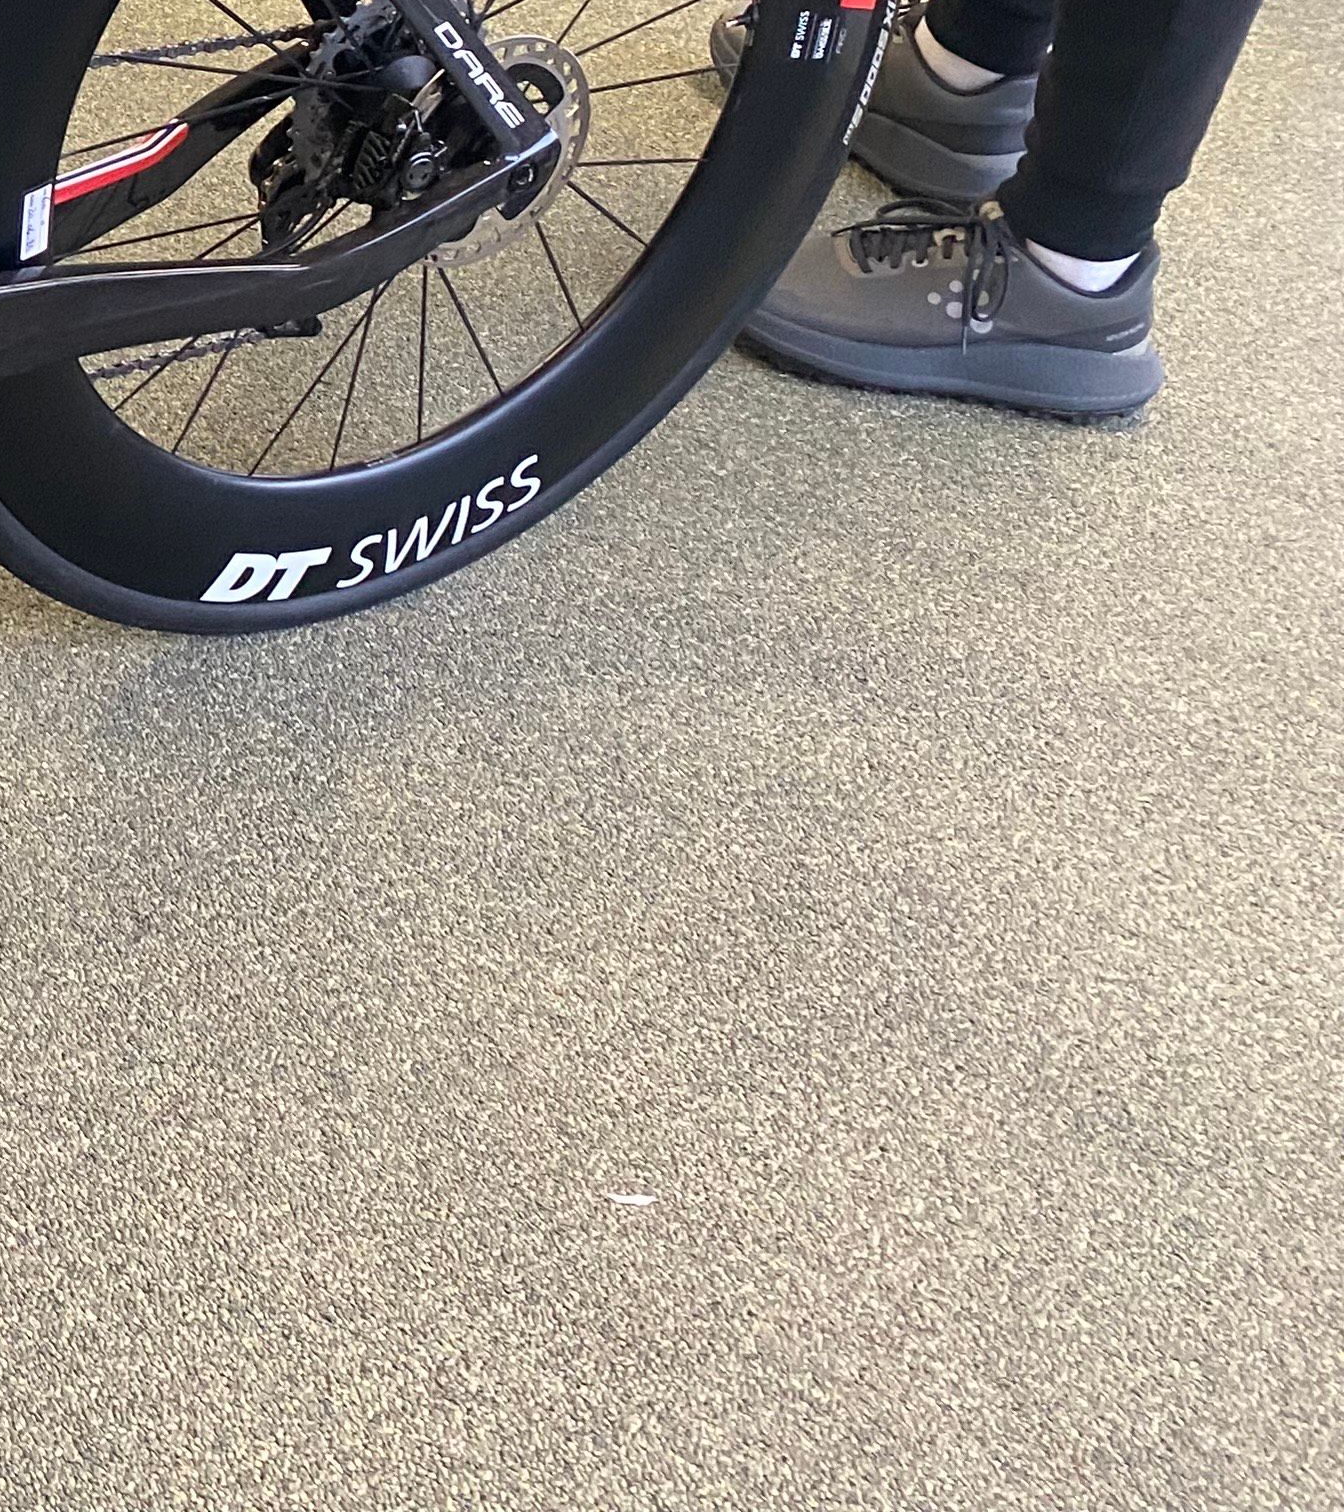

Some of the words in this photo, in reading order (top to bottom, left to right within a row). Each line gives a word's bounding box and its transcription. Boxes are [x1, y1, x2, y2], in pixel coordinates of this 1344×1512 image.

[434, 21, 525, 129] DARE
[794, 10, 810, 41] SWISS
[200, 546, 332, 603] DT
[336, 454, 541, 588] SWISS
